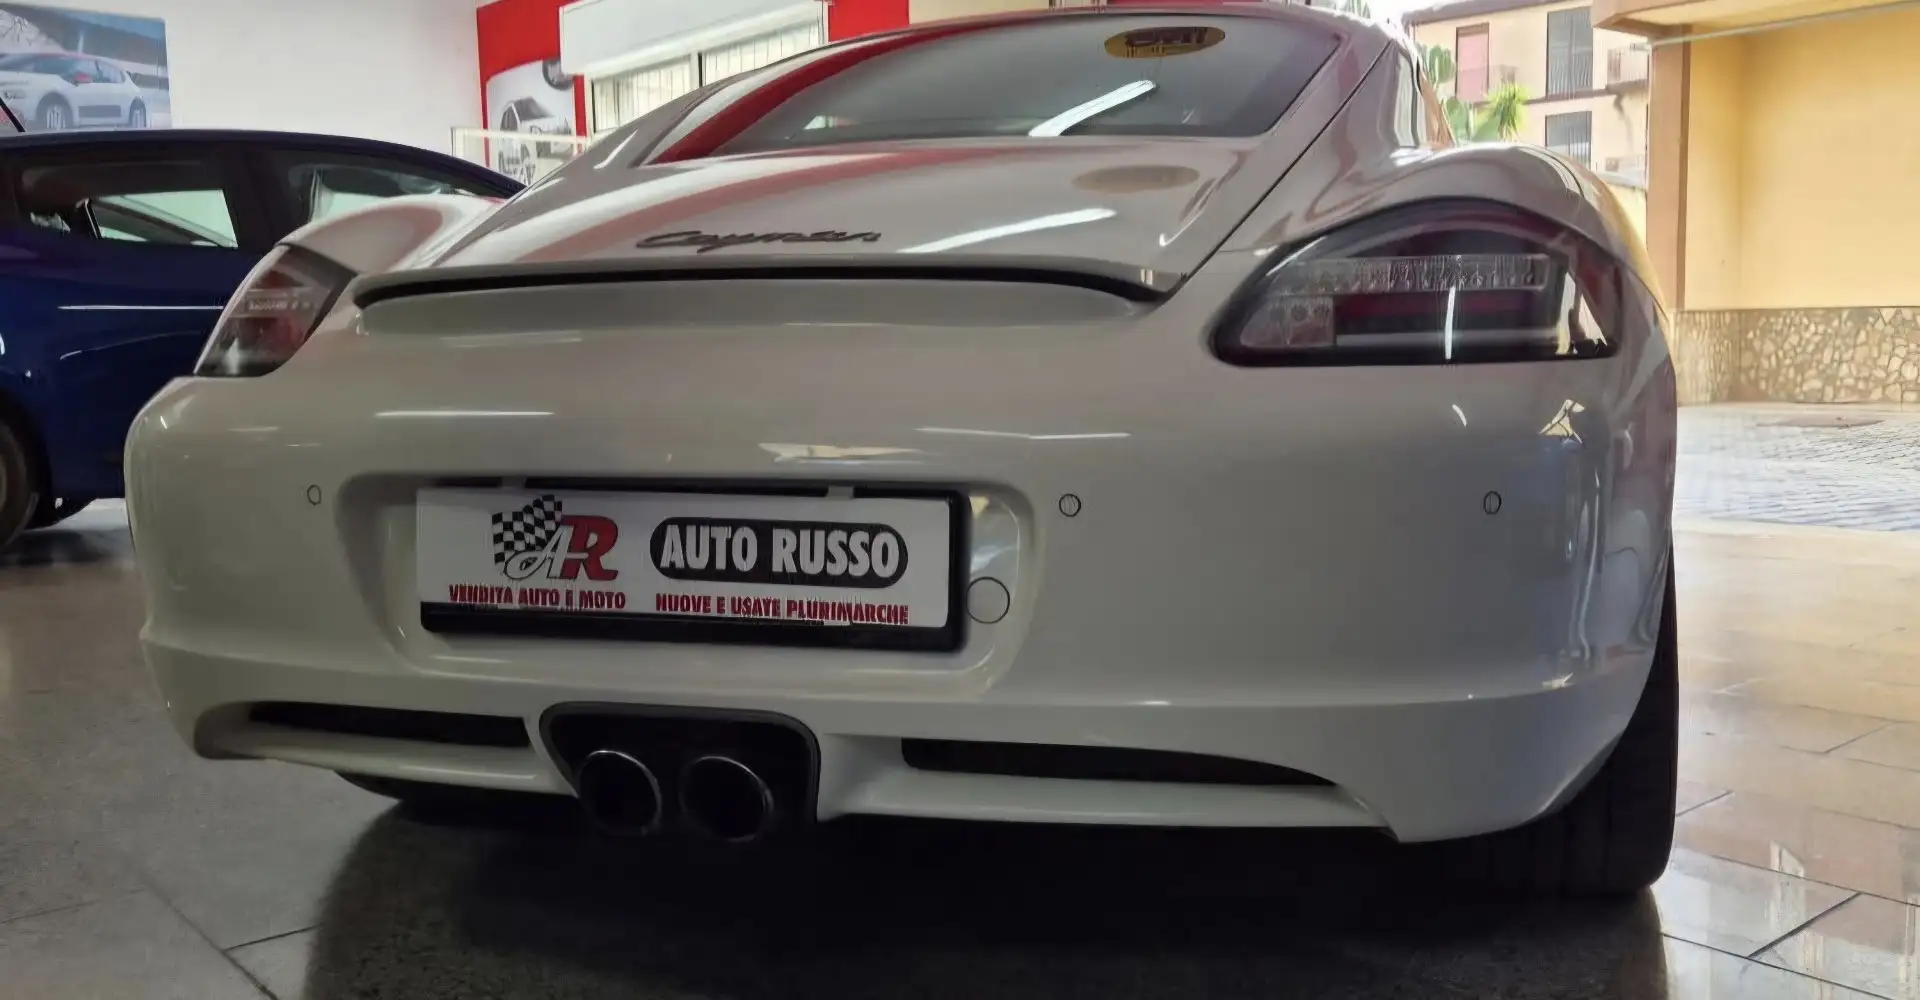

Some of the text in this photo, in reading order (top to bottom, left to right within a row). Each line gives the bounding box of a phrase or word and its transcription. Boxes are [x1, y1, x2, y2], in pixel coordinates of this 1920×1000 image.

[660, 524, 900, 578] AUTO RUSSO
[518, 587, 560, 607] AUTO
[579, 591, 626, 609] MOTO
[655, 593, 909, 625] NUOVE E USATE PLURIMARCHE
